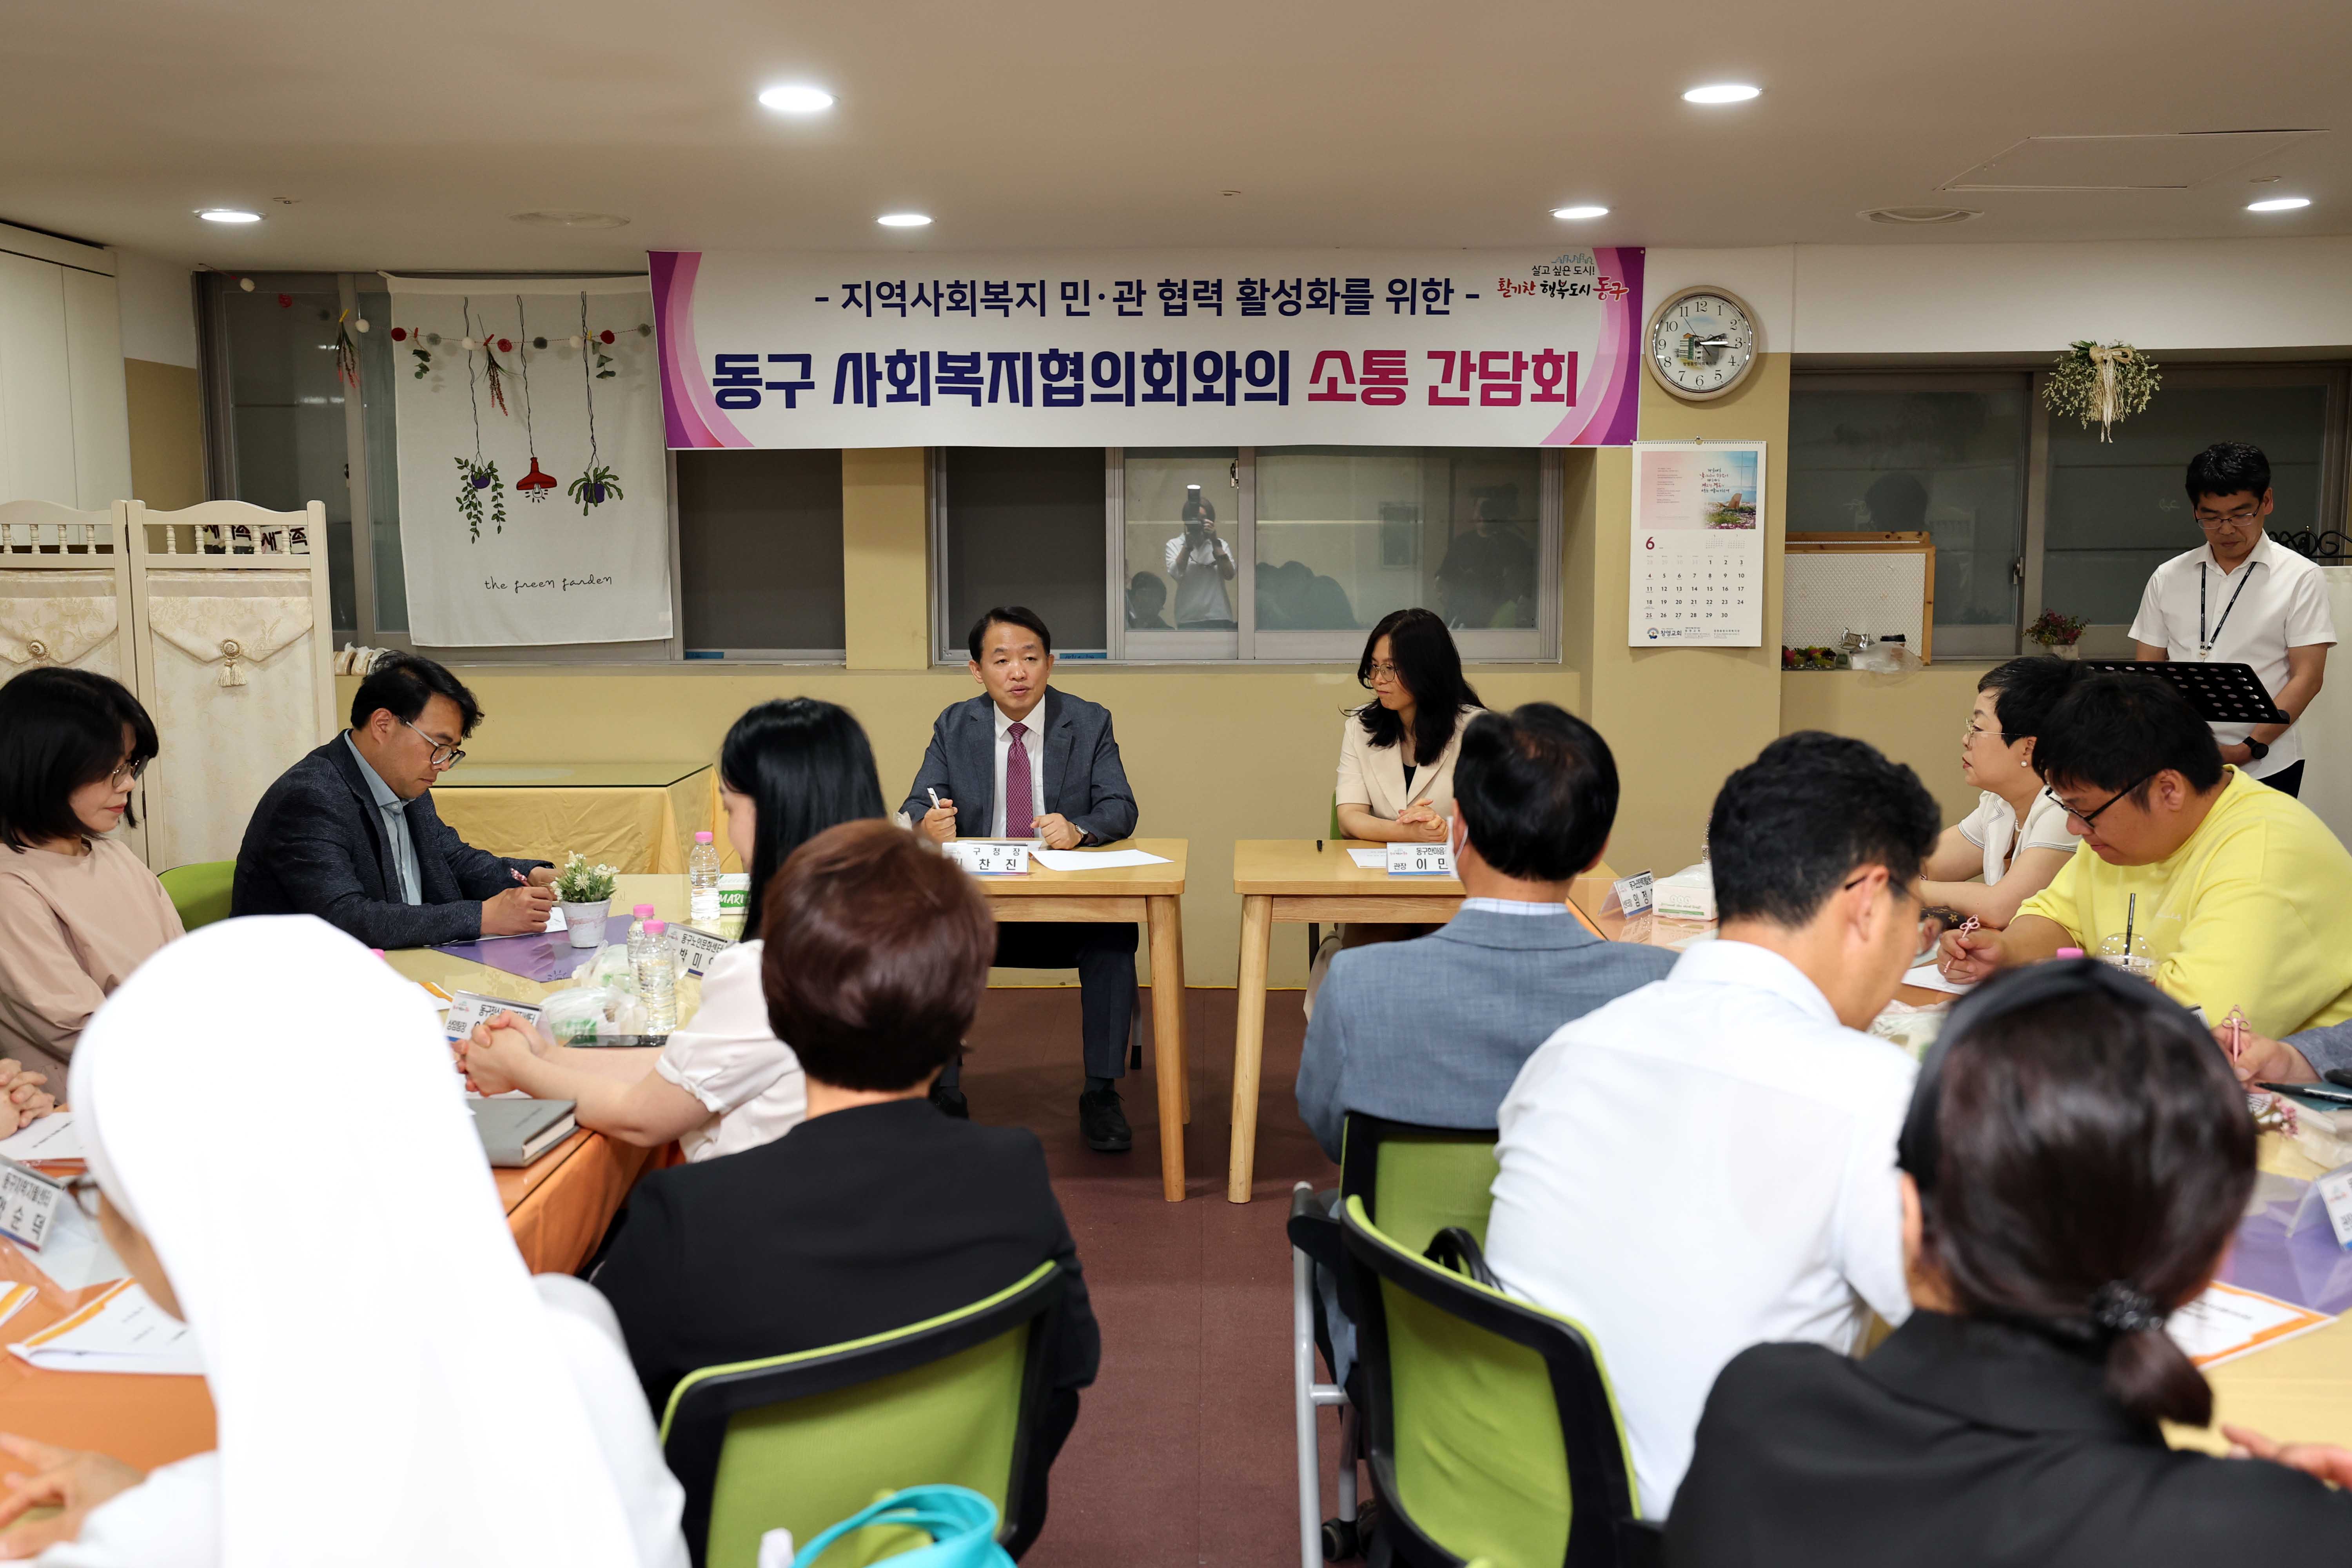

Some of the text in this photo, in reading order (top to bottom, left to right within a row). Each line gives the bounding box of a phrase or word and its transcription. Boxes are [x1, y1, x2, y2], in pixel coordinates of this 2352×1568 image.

[1532, 265, 1595, 276] 살고 싶은 도시!
[1497, 277, 1628, 300] 활기찬 행복도시 동구
[841, 278, 1048, 318] 지역사회복지
[1060, 279, 1147, 316] 민·관
[1157, 278, 1222, 317] 협력
[1236, 277, 1374, 316] 활성화를
[1386, 277, 1455, 316] 위한
[1679, 306, 1688, 317] 11
[1695, 301, 1708, 312] 12
[1718, 305, 1721, 316] 1
[1665, 321, 1678, 332] 10
[1730, 319, 1737, 330] 2
[1658, 339, 1666, 350] 9
[1735, 337, 1743, 349] 3
[1664, 356, 1672, 368] 8
[1728, 355, 1737, 366] 4
[713, 348, 1578, 409] 동구 사회복지협의회와의 소통 간담회
[1678, 370, 1686, 382] 7
[1695, 375, 1704, 386] 6
[1714, 370, 1722, 381] 5
[1645, 536, 1655, 550] 6
[484, 576, 508, 590] the
[1416, 847, 1446, 855] 동구한마음
